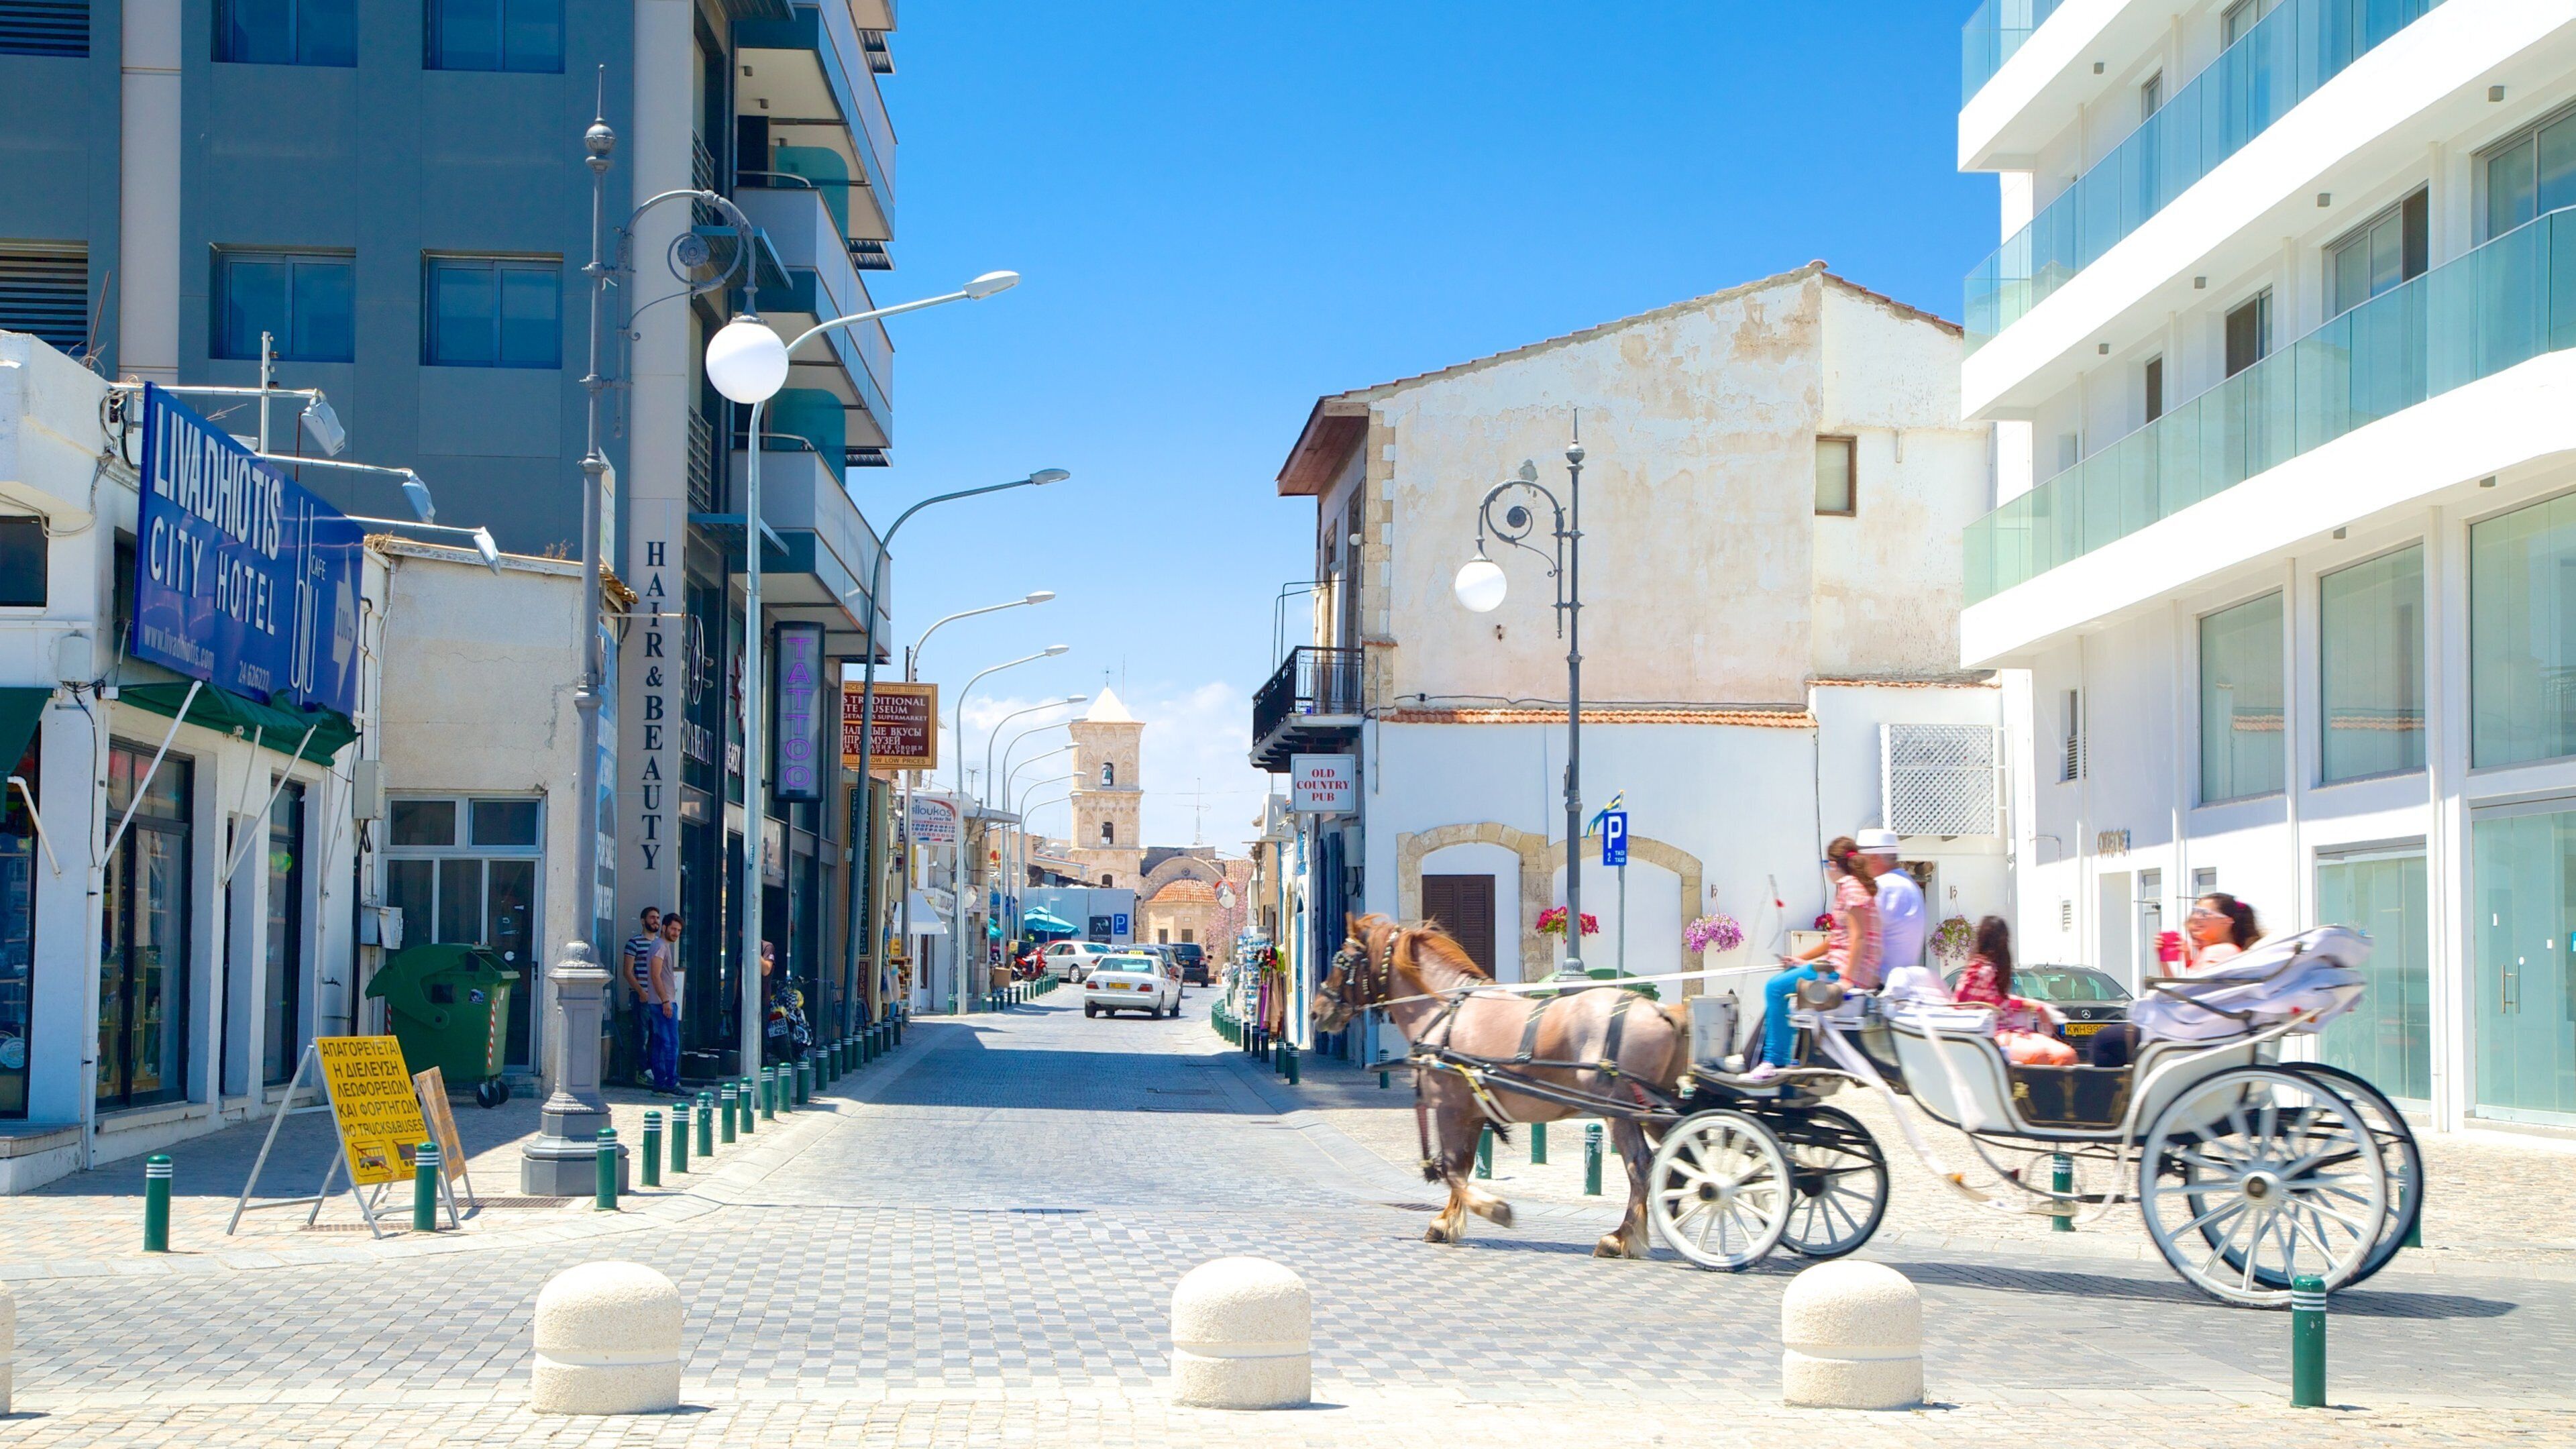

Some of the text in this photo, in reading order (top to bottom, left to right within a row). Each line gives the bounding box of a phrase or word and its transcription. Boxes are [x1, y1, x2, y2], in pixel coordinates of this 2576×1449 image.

[154, 402, 280, 560] LIVADHIOTIS
[150, 516, 275, 635] CITY HOTEL
[311, 555, 326, 582] CAFE
[144, 624, 215, 672] www.livadhiotis.com
[238, 660, 247, 684] 24
[850, 696, 926, 706] TRDITIONAL
[861, 705, 908, 714] USEUM
[785, 638, 813, 787] TATTOO
[870, 735, 900, 745] МУЗЕЙ
[891, 727, 922, 737] ВКУСЫ
[1311, 769, 1335, 778] OLD
[1297, 780, 1350, 790] COUNTRY
[1312, 792, 1335, 802] PUB
[1608, 816, 1623, 849] P
[1116, 916, 1126, 930] P
[323, 1040, 400, 1058] ΑΠΑΓΟΡΕΥΕΤΑΙ
[333, 1061, 400, 1079] Η ΔΙΕΛΕΥΣΗ
[337, 1079, 409, 1097] ΛΕΩΦΟΡΕΙΩΝ
[337, 1099, 419, 1119] ΚΑΙ ΦΟΡΤΗΓΩΝ
[341, 1118, 425, 1138] NO TRUCKS&BUSES
